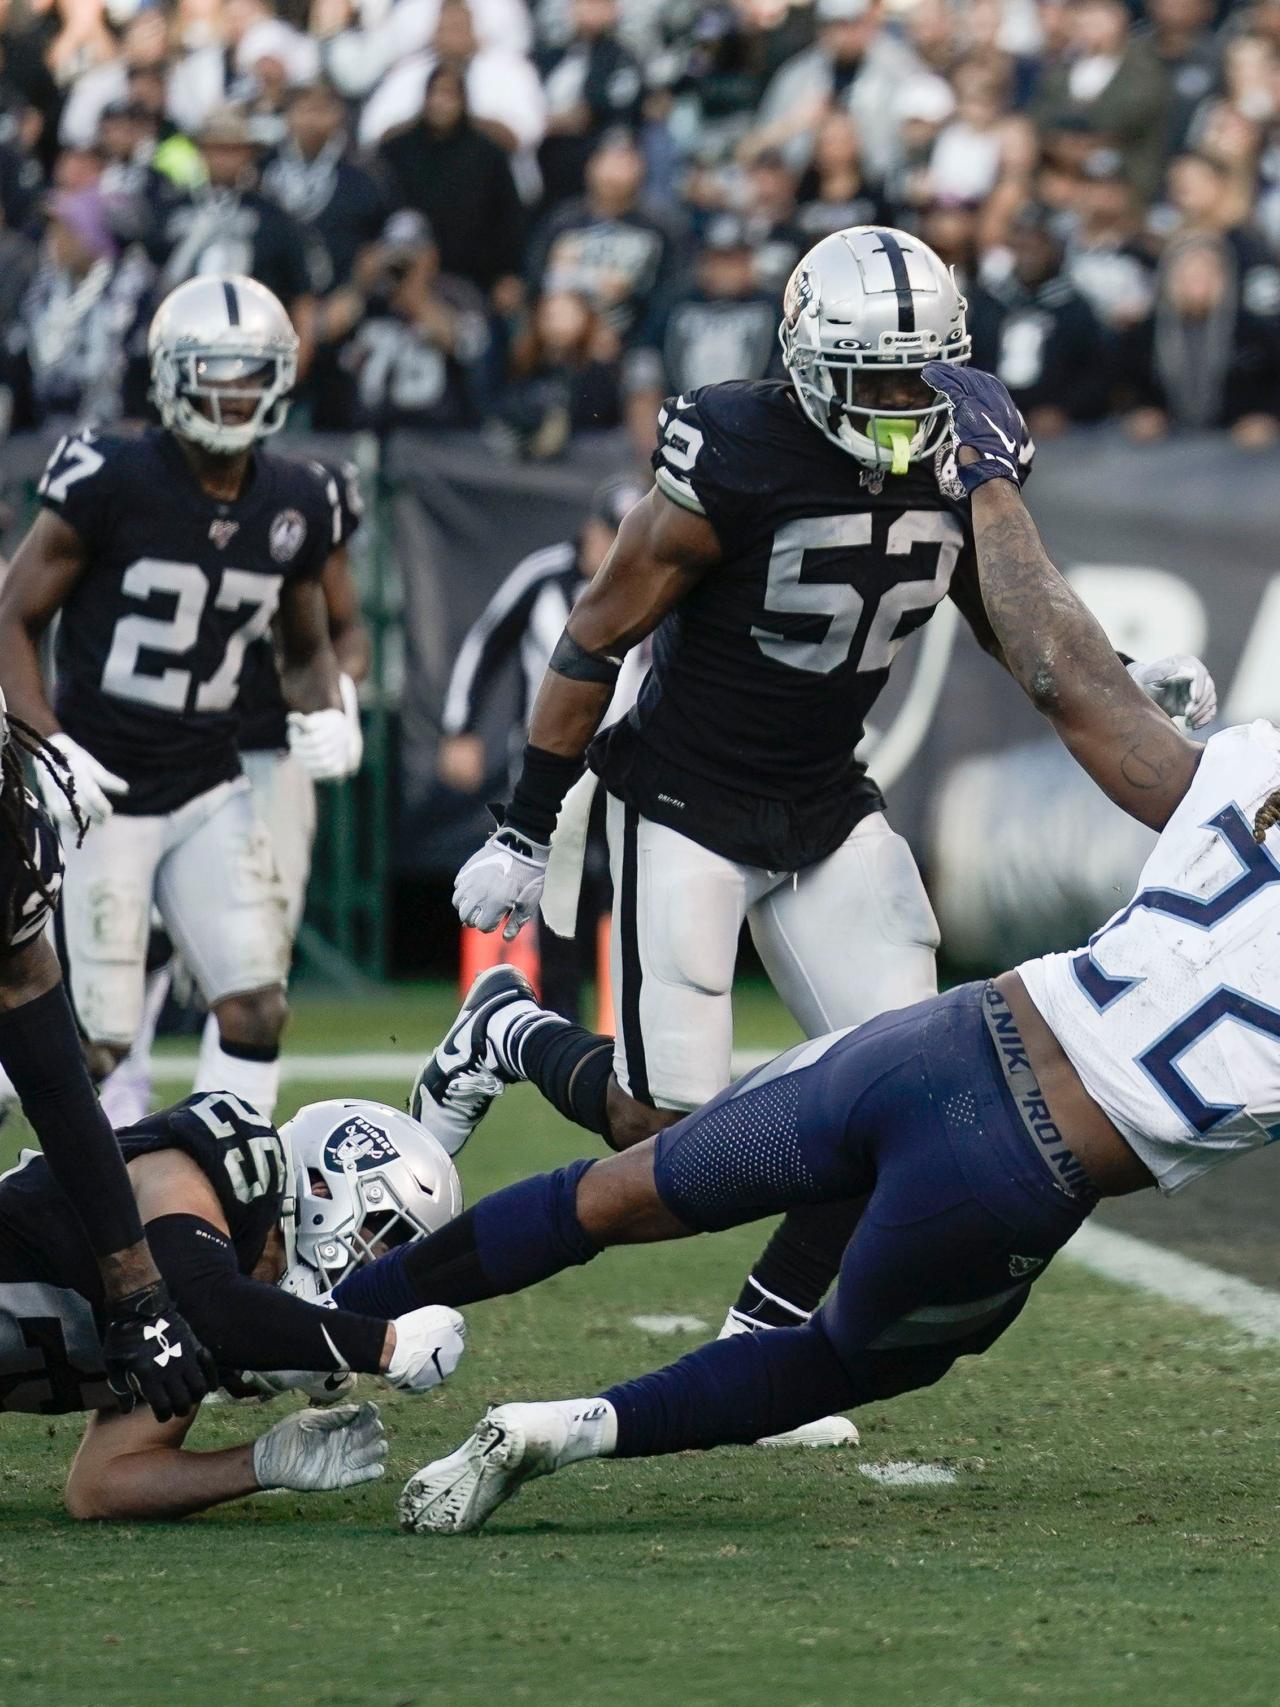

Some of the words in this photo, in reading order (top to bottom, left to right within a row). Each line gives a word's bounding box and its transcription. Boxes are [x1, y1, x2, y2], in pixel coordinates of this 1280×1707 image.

[38, 434, 105, 502] 7
[658, 406, 704, 471] 2
[751, 510, 964, 675] 52
[101, 557, 284, 713] 27
[991, 1012, 1032, 1074] NIK
[190, 1093, 287, 1205] 25
[354, 1118, 396, 1156] RAIDERS
[195, 1229, 228, 1249] DRI-FIT
